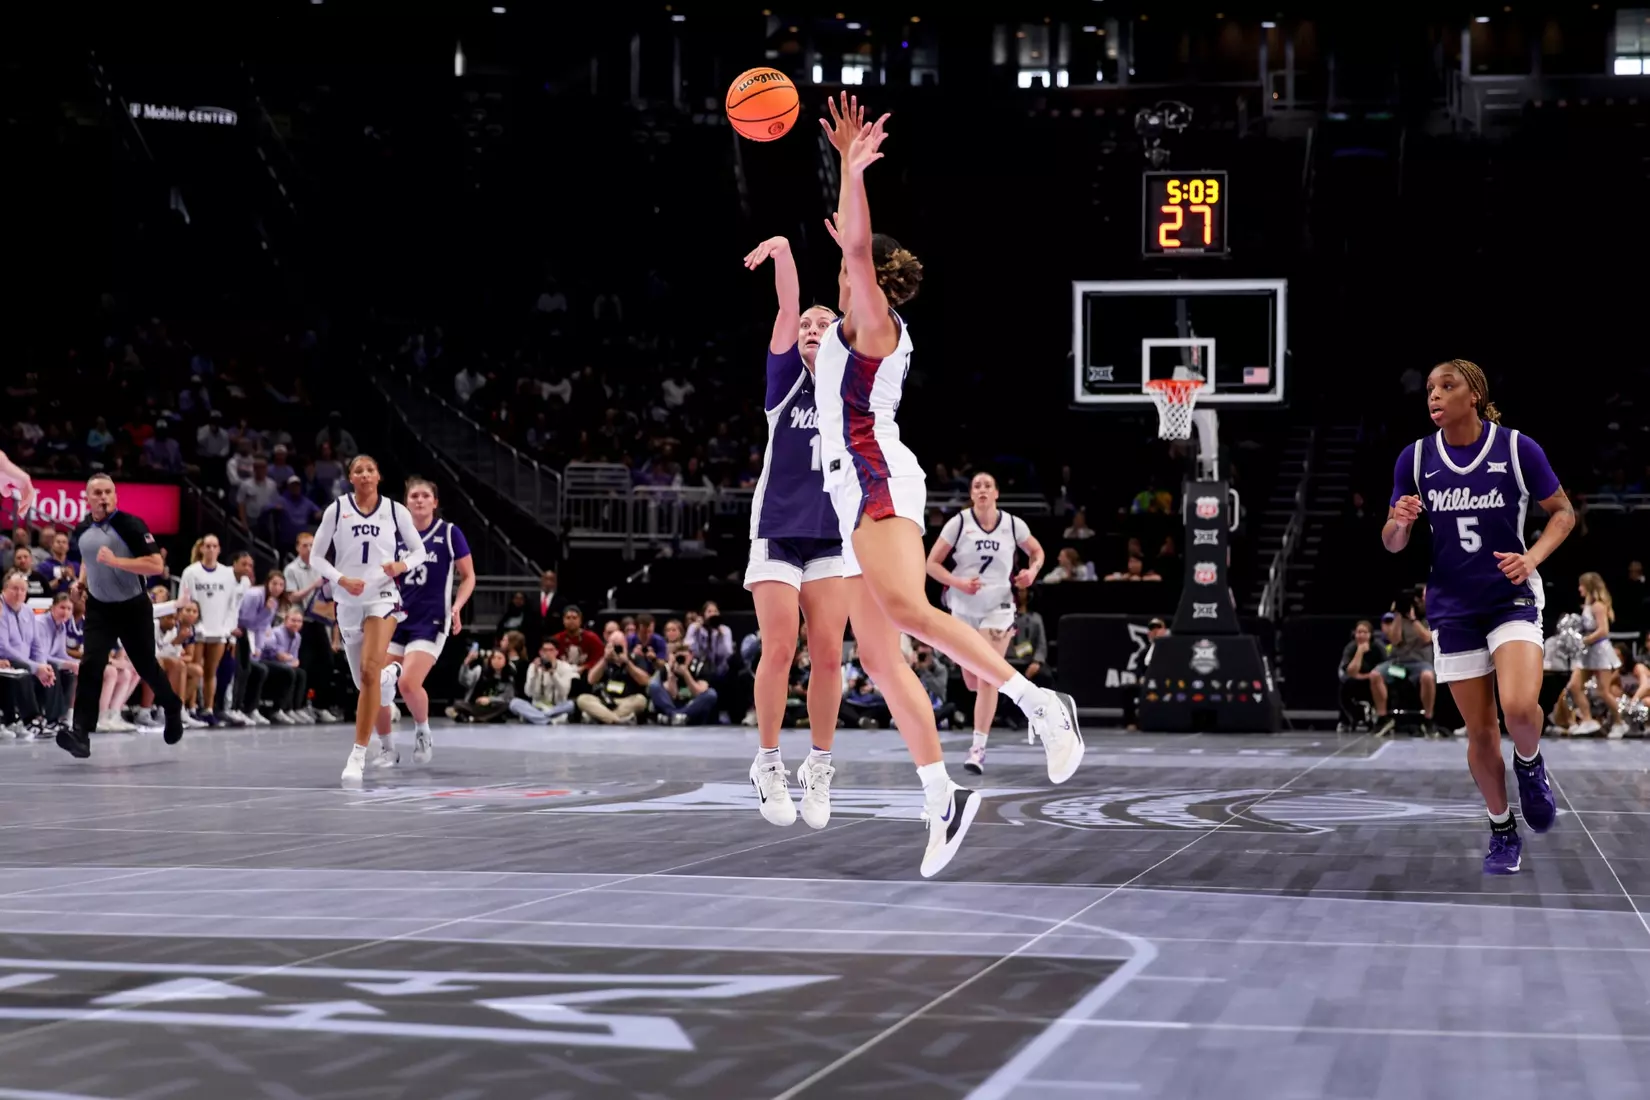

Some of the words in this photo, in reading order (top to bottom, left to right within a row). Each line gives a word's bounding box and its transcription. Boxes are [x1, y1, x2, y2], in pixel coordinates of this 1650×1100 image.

[738, 72, 785, 92] Wilson
[143, 103, 187, 121] Mobile
[188, 109, 233, 125] CENTER
[1166, 179, 1219, 204] 5:03
[1159, 204, 1212, 247] 27
[790, 406, 820, 429] Wil
[9, 487, 90, 523] Mobi
[1428, 487, 1506, 512] Wildcats
[351, 524, 380, 538] TCU
[1456, 516, 1482, 553] 5
[361, 541, 370, 564] 1
[975, 540, 1000, 551] TCU
[404, 564, 428, 586] 23
[979, 555, 993, 575] 7
